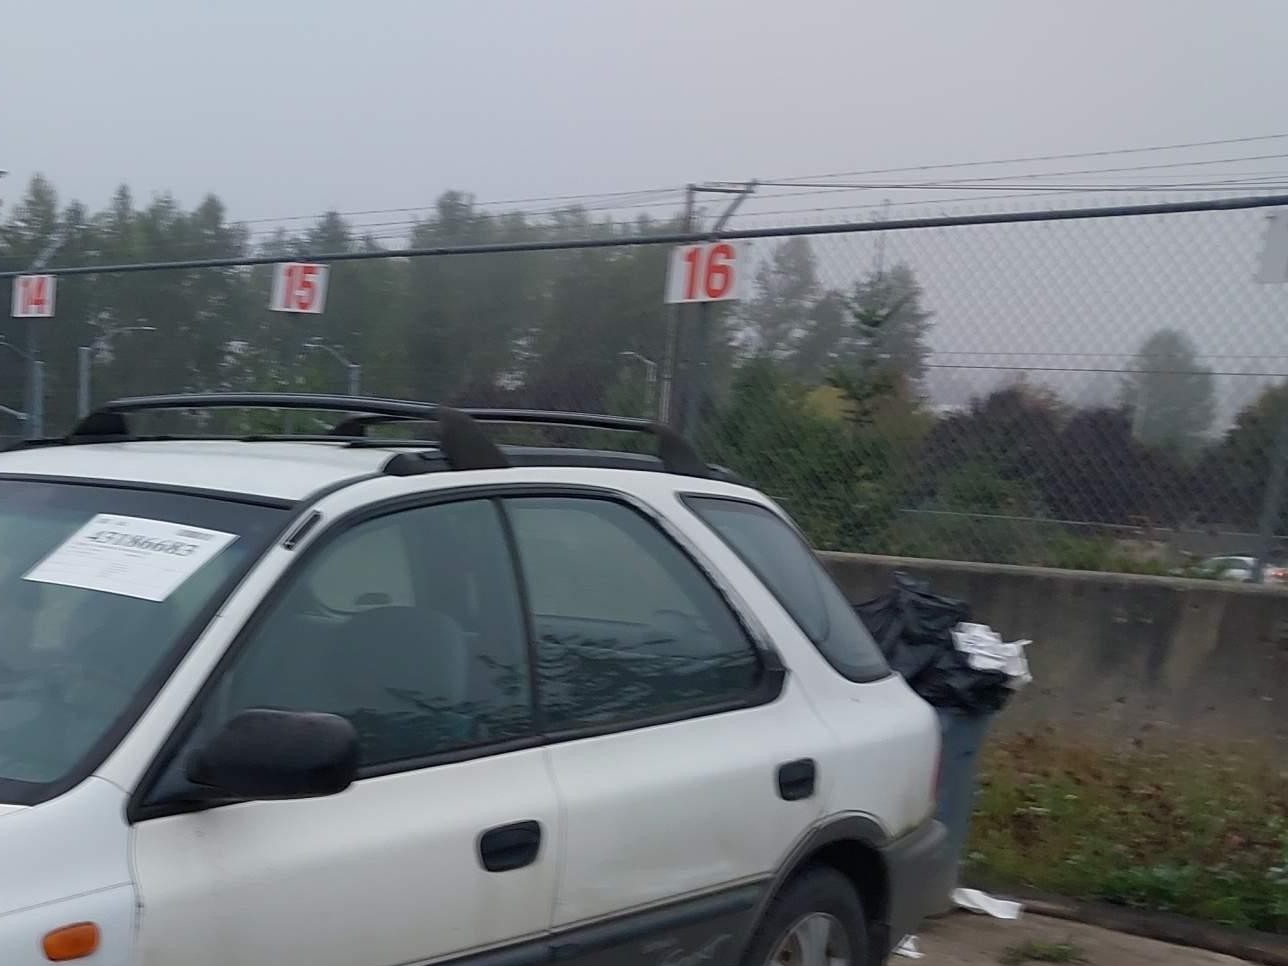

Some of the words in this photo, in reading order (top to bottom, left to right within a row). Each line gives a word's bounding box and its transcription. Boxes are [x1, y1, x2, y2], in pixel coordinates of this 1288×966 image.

[284, 265, 318, 310] 15
[684, 244, 735, 299] 16
[20, 278, 47, 313] 14
